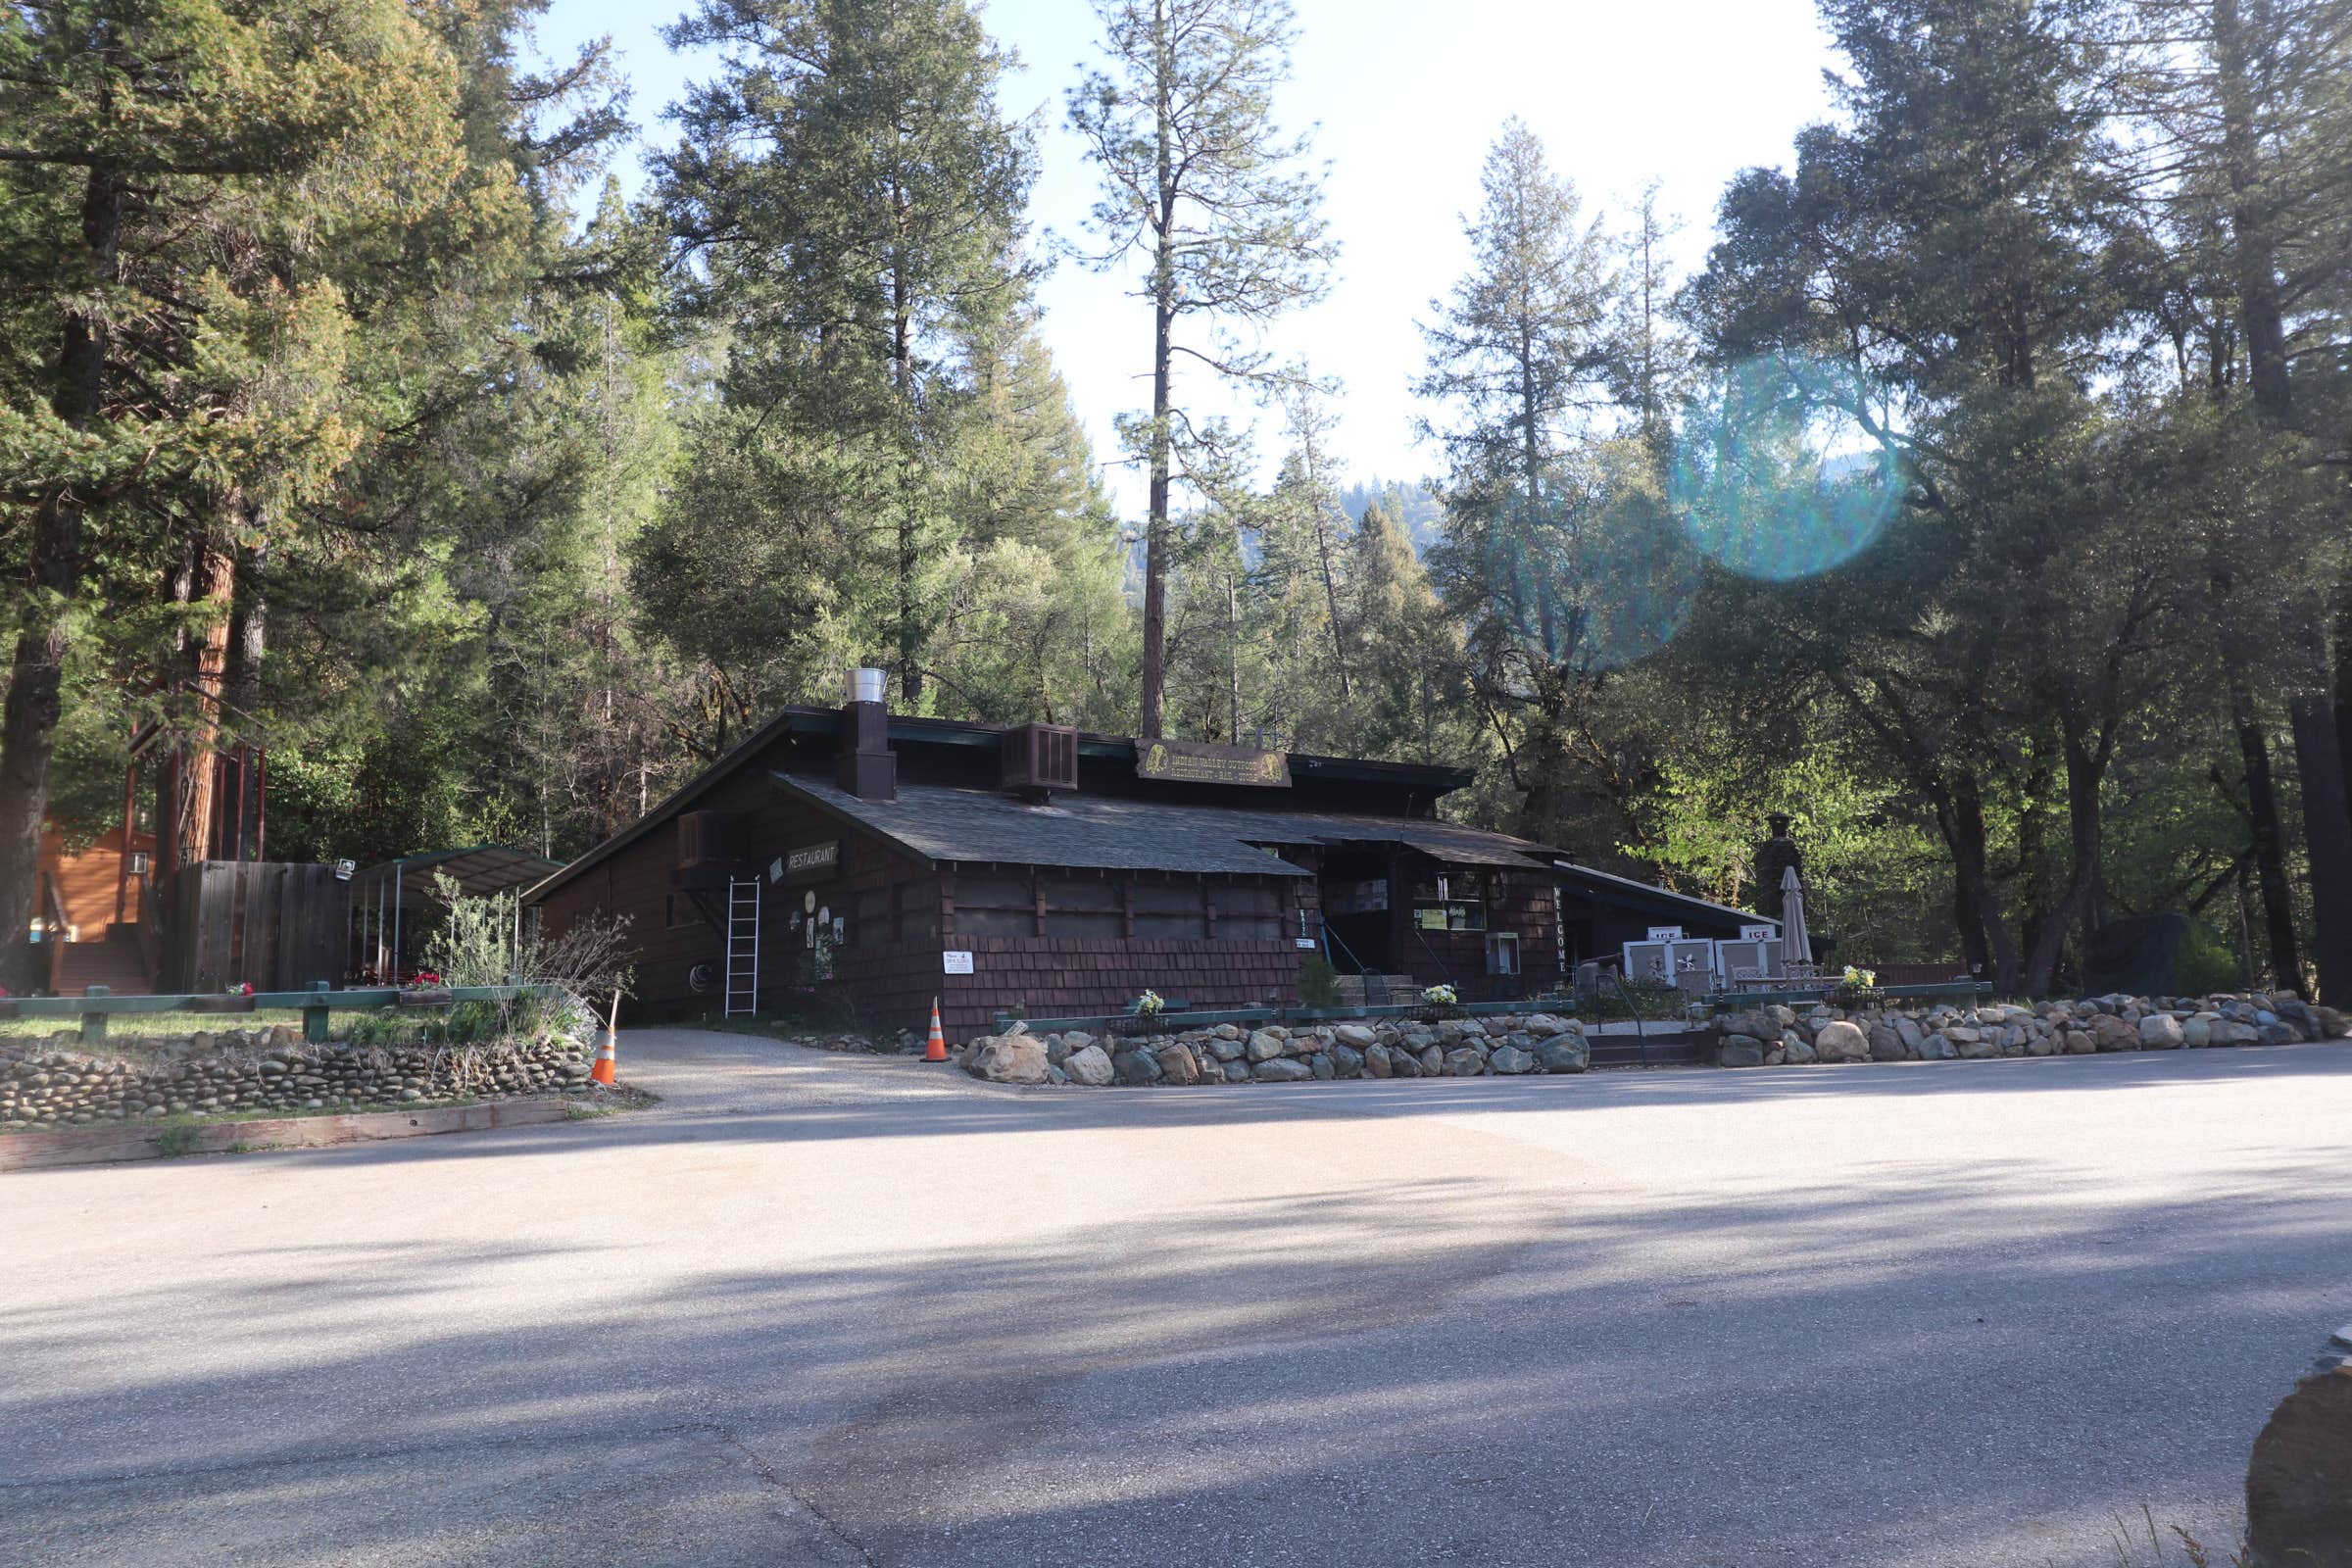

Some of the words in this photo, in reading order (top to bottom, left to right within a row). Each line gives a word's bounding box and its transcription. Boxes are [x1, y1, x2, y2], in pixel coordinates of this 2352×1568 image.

[1172, 755, 1198, 767] INDIAN
[1199, 758, 1226, 769] VALLEY
[1228, 760, 1257, 771] OUTPOST
[1171, 767, 1214, 780] RESTAURANT
[1218, 770, 1234, 781] BAR
[1238, 772, 1258, 782] STORE
[788, 847, 836, 870] RESTAURANT
[1553, 887, 1566, 972] WELCOME
[1748, 931, 1769, 940] ICE
